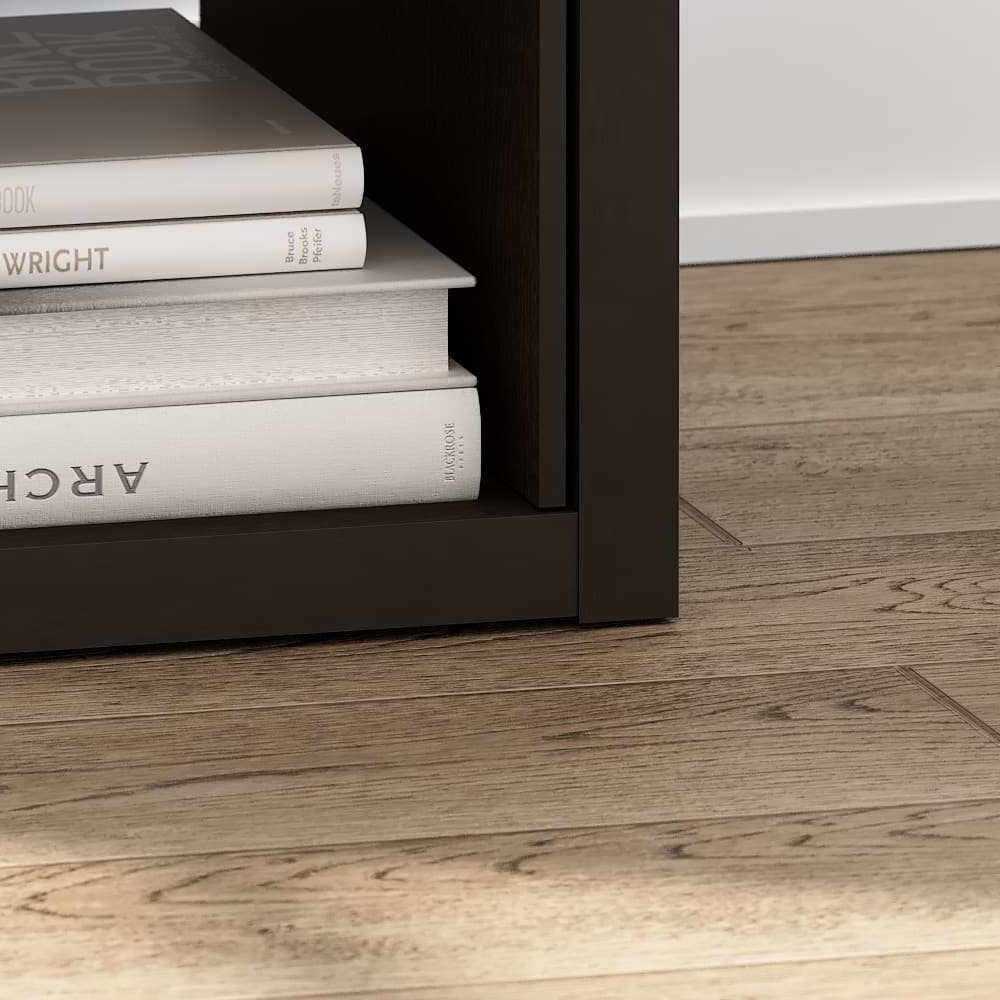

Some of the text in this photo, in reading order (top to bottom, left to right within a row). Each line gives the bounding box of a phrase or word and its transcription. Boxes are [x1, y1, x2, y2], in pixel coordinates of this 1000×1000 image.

[38, 26, 210, 87] BOOK
[3, 248, 109, 276] WRIGHT
[285, 231, 294, 263] Bruce
[298, 227, 309, 264] Brooks
[313, 228, 323, 263] Pfeifer
[444, 423, 455, 481] BLACKROSE
